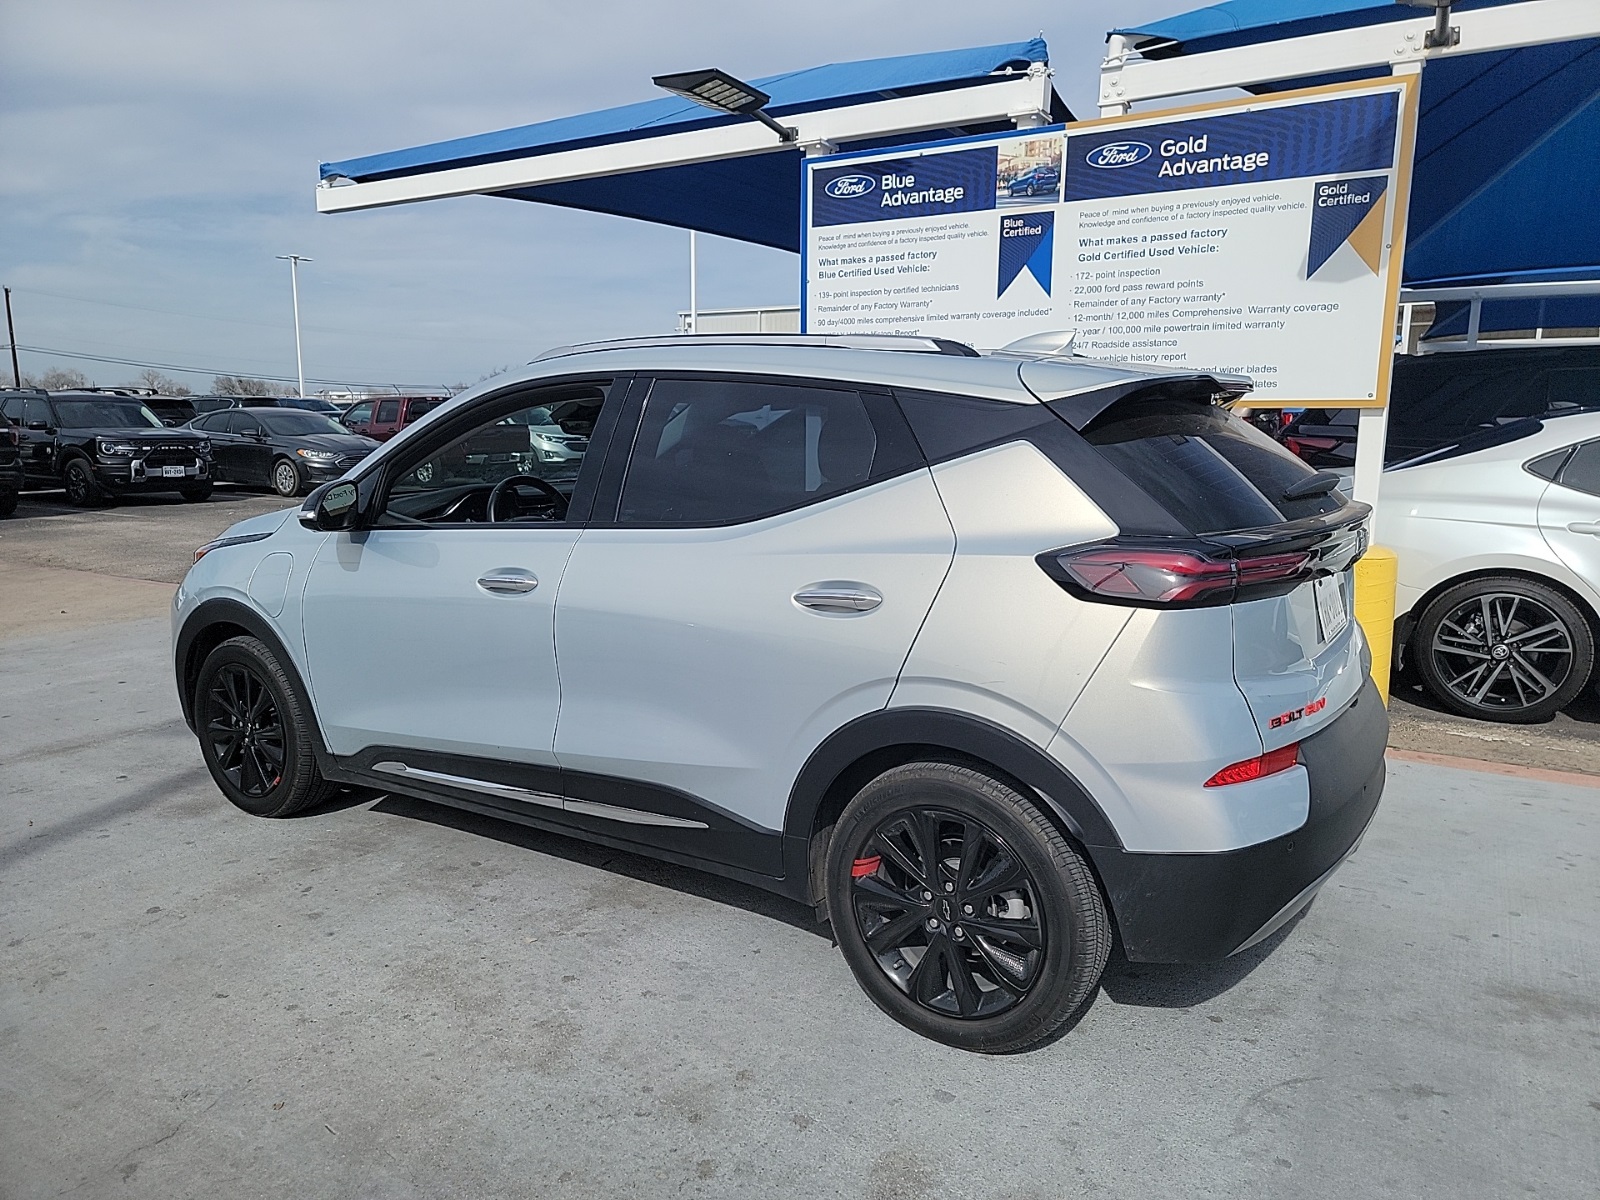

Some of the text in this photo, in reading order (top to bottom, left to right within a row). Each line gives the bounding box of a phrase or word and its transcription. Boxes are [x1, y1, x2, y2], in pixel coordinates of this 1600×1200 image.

[1160, 134, 1208, 157] Gold
[1098, 145, 1139, 164] Ford
[1158, 152, 1269, 178] Advantage
[834, 178, 866, 195] Ford
[882, 174, 915, 190] Blue
[1319, 183, 1348, 196] Gold
[881, 186, 964, 207] Advantage
[1318, 192, 1370, 207] Certified
[1080, 211, 1100, 219] Peace
[1112, 208, 1129, 216] mind
[1130, 206, 1149, 214] when
[1150, 204, 1174, 213] buying
[1182, 199, 1219, 210] previously
[1221, 196, 1251, 206] enjoyed
[1252, 193, 1282, 203] vehicle.
[1003, 218, 1024, 228] Blue
[1079, 220, 1115, 229] Knowledge
[1131, 215, 1169, 224] confidence
[1186, 210, 1210, 219] factory
[1212, 207, 1248, 217] inspected
[1250, 204, 1275, 214] quality
[1277, 202, 1307, 211] vehicle.
[896, 227, 923, 235] previously
[925, 225, 947, 233] enjoyed
[900, 236, 917, 244] factory
[919, 234, 945, 242] inspected
[947, 232, 965, 240] quality
[1003, 225, 1042, 237] Certified
[1079, 237, 1104, 247] What
[1106, 235, 1138, 245] makes
[1150, 230, 1187, 244] passed
[1190, 228, 1228, 238] factory
[819, 258, 838, 267] What
[841, 256, 866, 265] makes
[875, 252, 905, 264] passed
[907, 251, 937, 260] factory
[1078, 244, 1220, 262] Gold Certified Used Vehicle:
[838, 268, 872, 278] Certified
[874, 267, 895, 275] Used
[897, 264, 930, 273] Vehicle:
[1075, 268, 1161, 281] 172- point inspection
[818, 284, 959, 299] 139- point inspection by certified technicians
[1074, 279, 1204, 295] 22,000 ford pass reward points
[818, 305, 851, 313] Remainder
[874, 302, 898, 310] Factory
[1073, 299, 1118, 309] Remainder
[1120, 297, 1130, 306] of
[1130, 297, 1146, 307] any
[1148, 295, 1181, 305] Factory
[827, 318, 855, 327] day/4000
[857, 316, 874, 324] miles
[875, 314, 925, 324] comprehensive
[950, 312, 980, 320] warranty
[982, 310, 1016, 319] coverage
[1073, 303, 1340, 322] 12-month/ 12,000 miles Comprehensive Warranty coverage
[1082, 328, 1101, 338] year
[1108, 325, 1142, 335] 100,000
[1143, 324, 1161, 333] mile
[1163, 322, 1210, 334] powertrain
[1212, 321, 1242, 330] limited
[1244, 320, 1285, 330] warranty
[1071, 339, 1178, 350] 24/7 Roadside assistance
[1130, 353, 1159, 363] history
[1161, 352, 1187, 362] report
[1219, 365, 1244, 374] wiper
[1247, 364, 1278, 373] blades
[1269, 708, 1305, 729] BOLT
